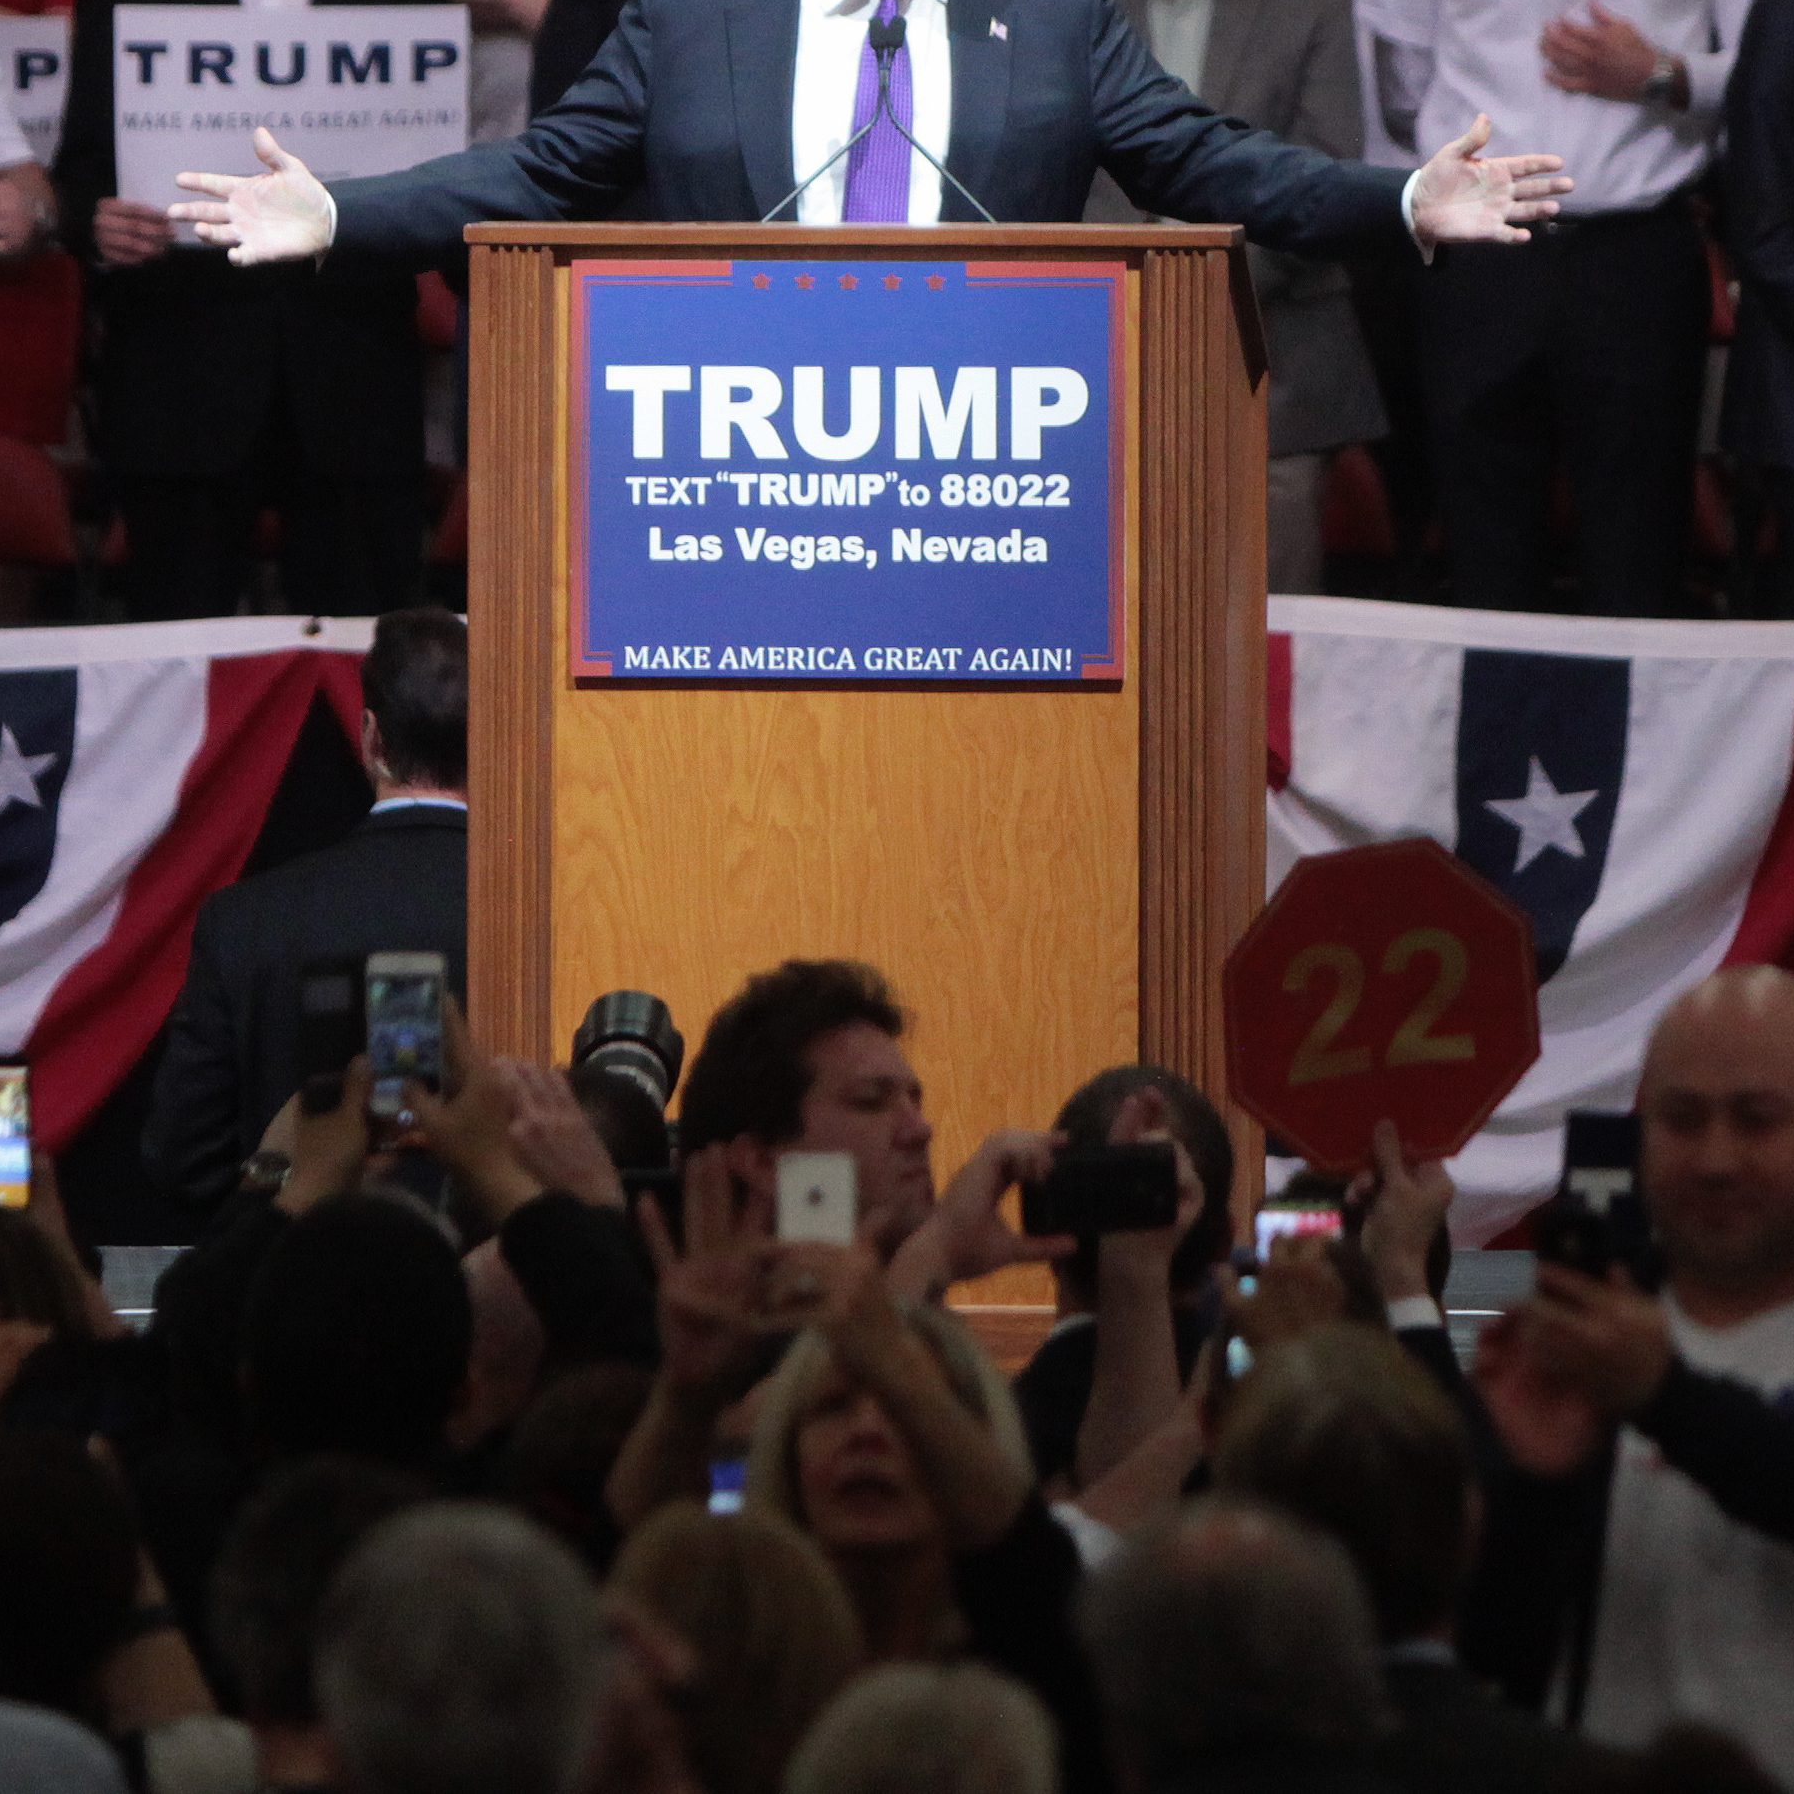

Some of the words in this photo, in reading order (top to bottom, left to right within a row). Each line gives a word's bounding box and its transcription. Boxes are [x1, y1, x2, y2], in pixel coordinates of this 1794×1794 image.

[124, 41, 458, 88] TRUMP
[124, 111, 182, 131] MAKE
[189, 110, 295, 131] AMERICA
[300, 109, 373, 130] GREAT
[606, 365, 1089, 460] TRUMP
[626, 476, 711, 506] TEXT
[899, 477, 931, 507] to
[940, 475, 1071, 507] 88022
[648, 527, 722, 561] Las
[735, 528, 877, 570] Vegas,
[891, 528, 1048, 564] Nevada
[624, 646, 711, 670] MAKE
[719, 646, 856, 672] AMERICA
[864, 647, 962, 673] GREAT
[969, 648, 1073, 674] AGAIN!
[1283, 927, 1476, 1085] 22
